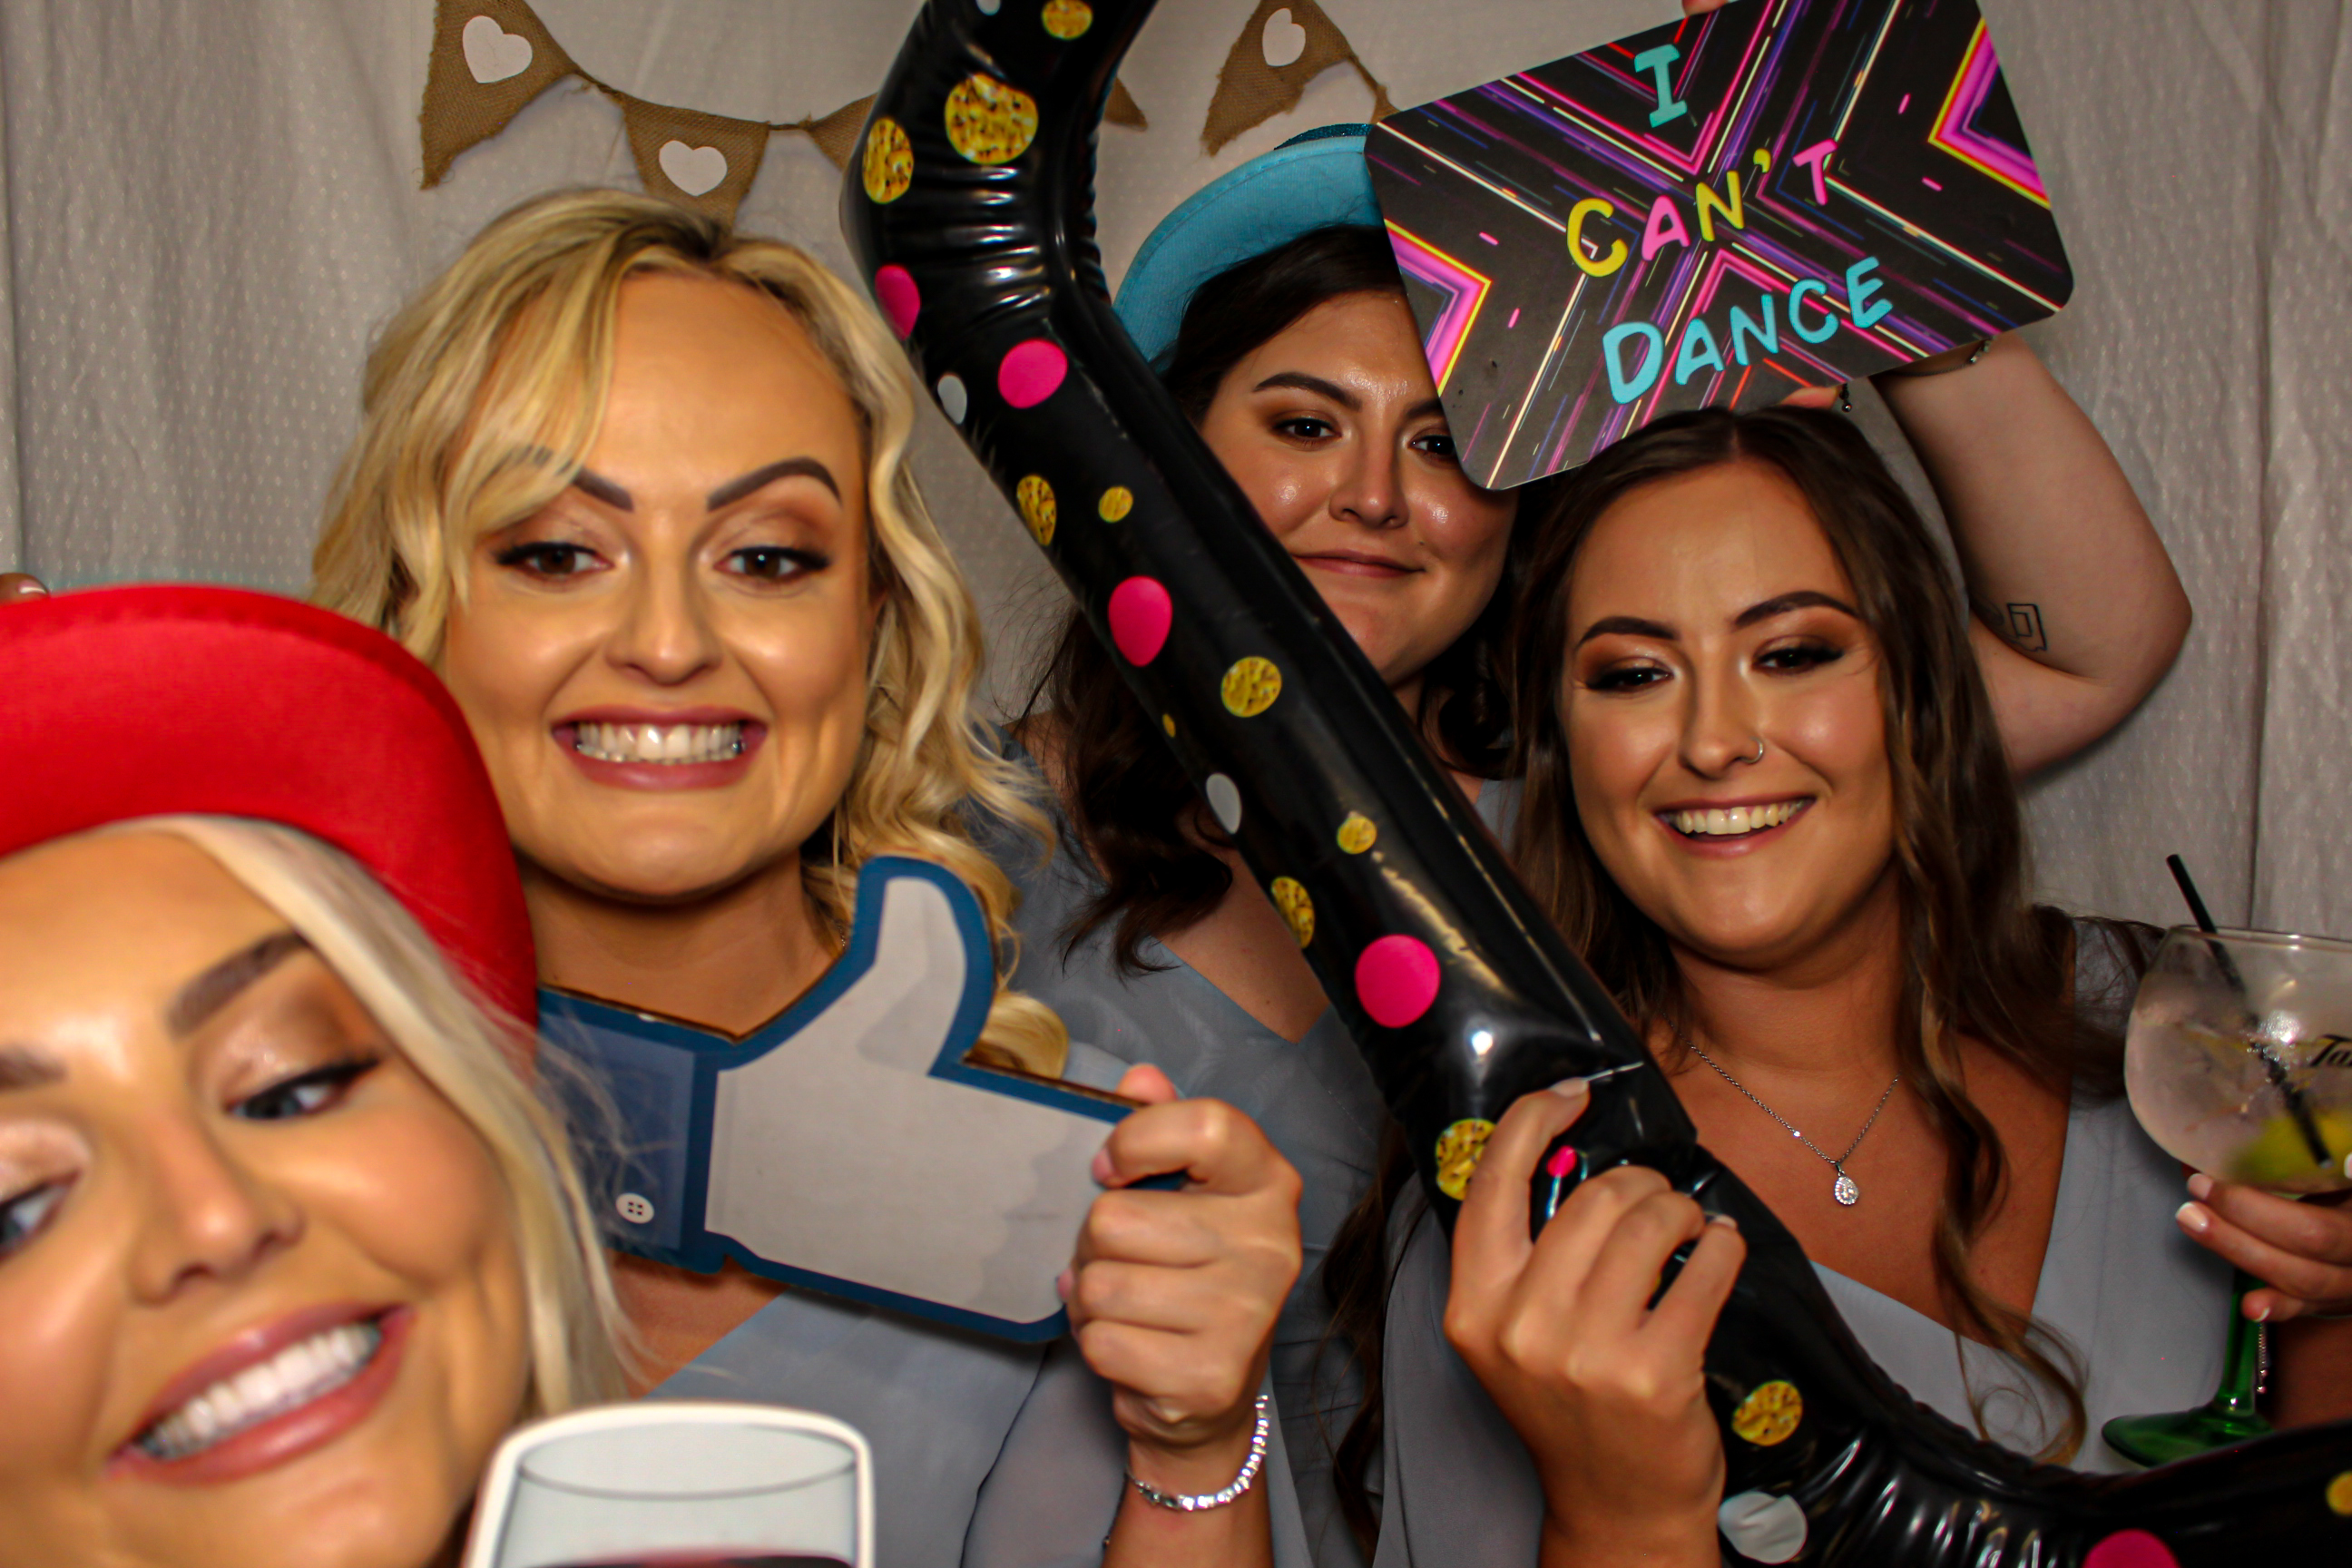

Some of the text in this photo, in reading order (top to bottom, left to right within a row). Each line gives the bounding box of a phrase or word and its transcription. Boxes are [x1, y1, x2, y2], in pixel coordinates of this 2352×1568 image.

[1634, 44, 1688, 127] I
[1567, 140, 1838, 278] CAN'T
[1602, 256, 1893, 405] DANCE
[2309, 1033, 2352, 1067] Ta
